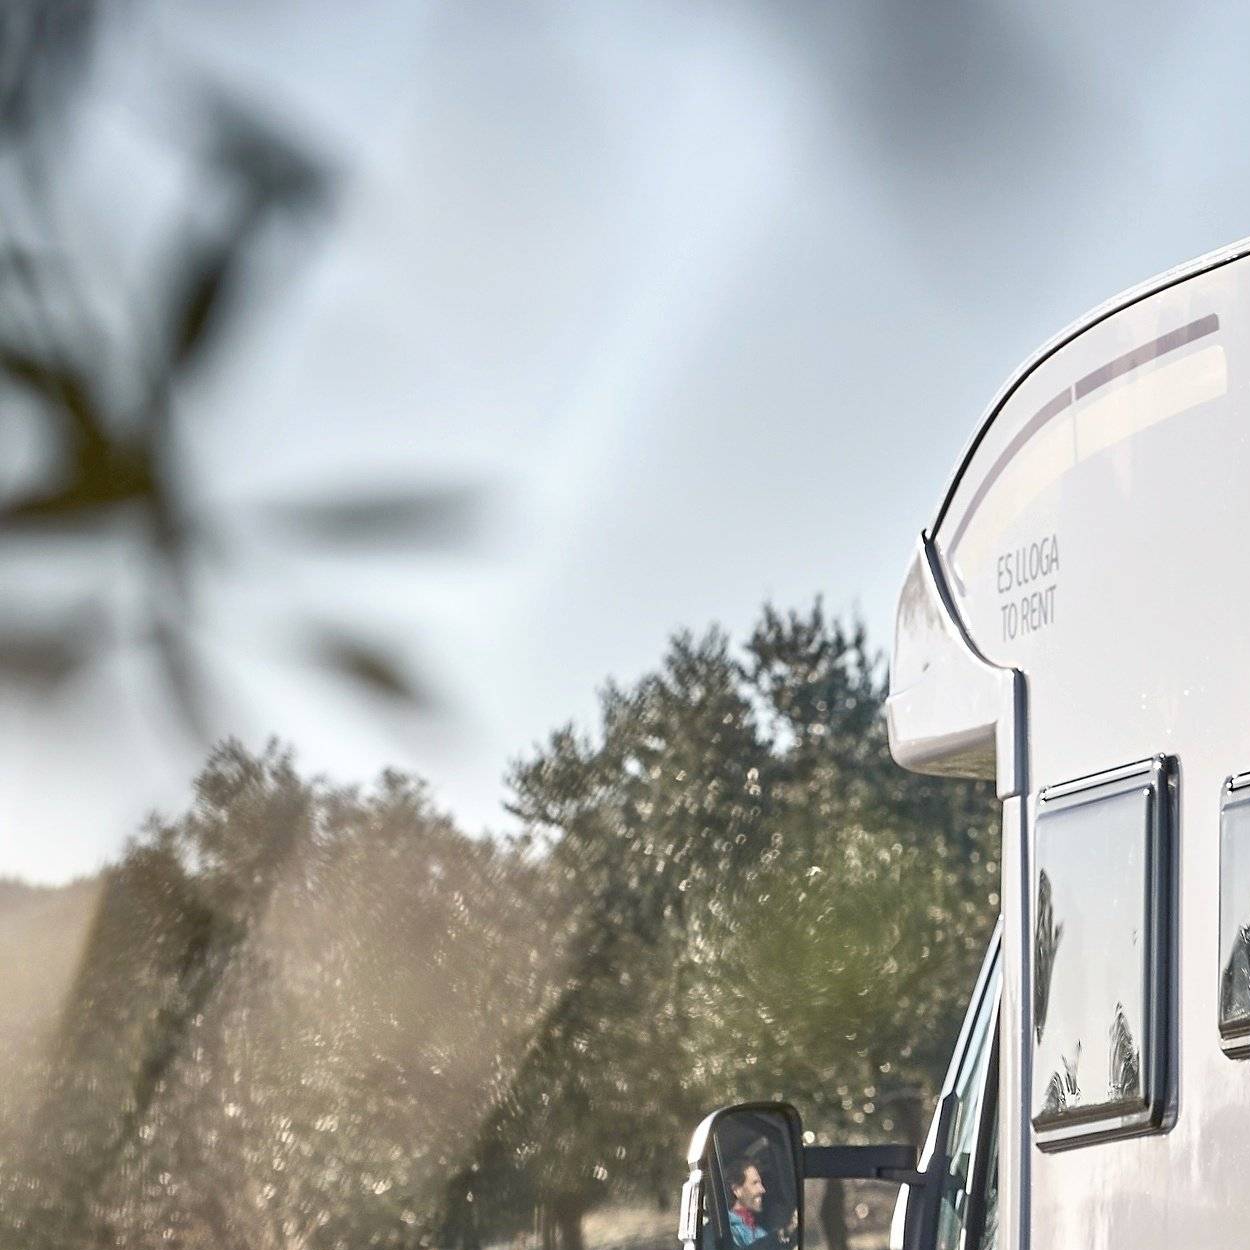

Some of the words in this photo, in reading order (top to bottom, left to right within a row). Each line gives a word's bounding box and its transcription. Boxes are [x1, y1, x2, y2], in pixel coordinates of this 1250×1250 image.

[997, 553, 1013, 594] ES
[1015, 534, 1060, 587] LLOGA
[1001, 602, 1018, 642] TO
[1021, 583, 1057, 635] RENT
